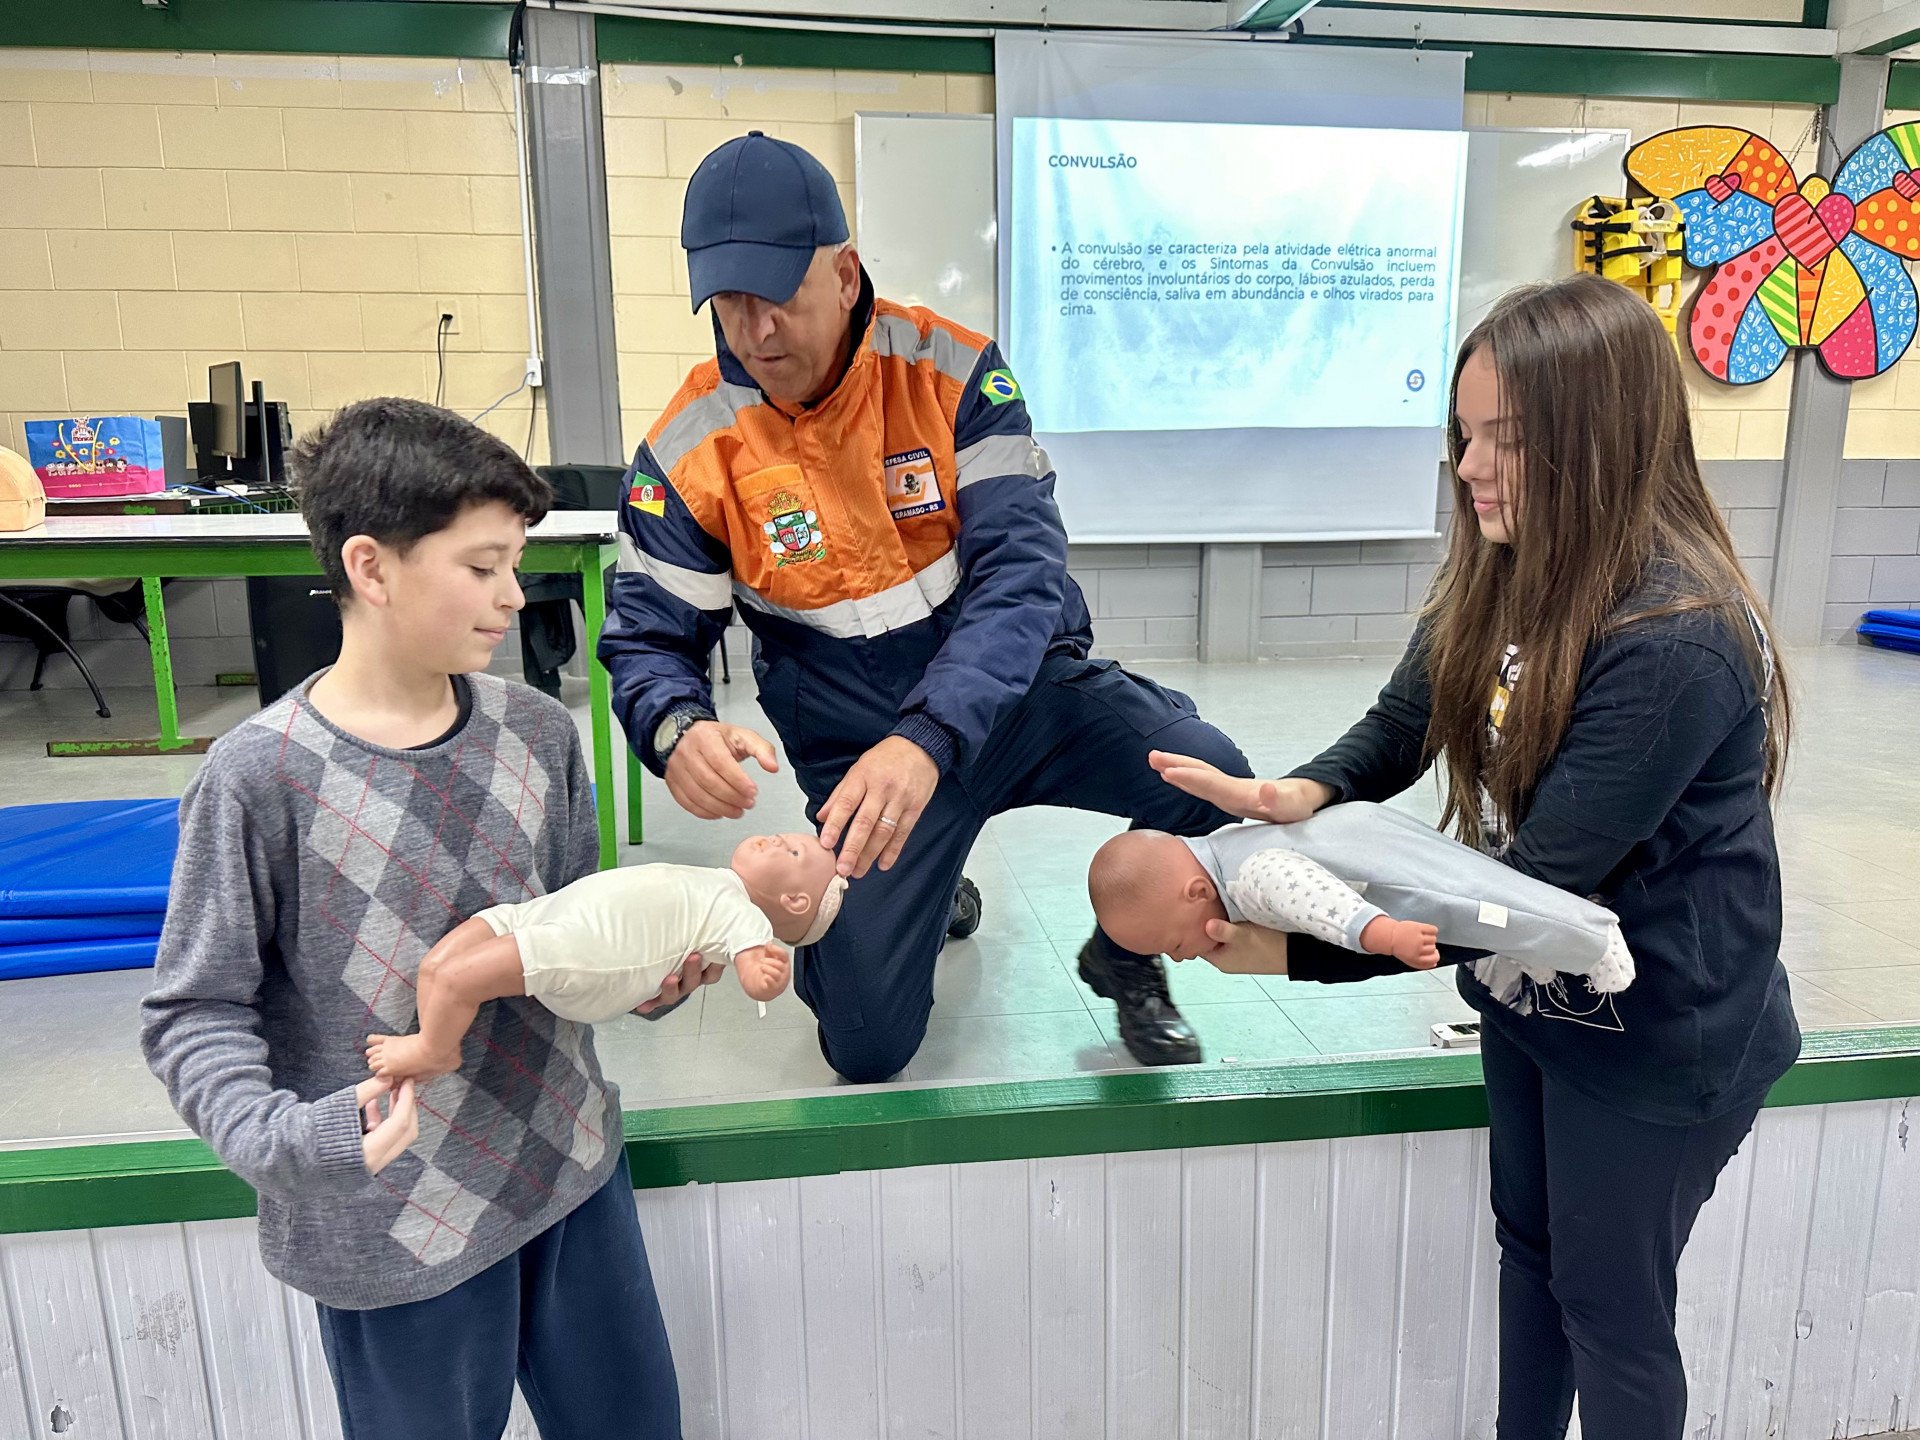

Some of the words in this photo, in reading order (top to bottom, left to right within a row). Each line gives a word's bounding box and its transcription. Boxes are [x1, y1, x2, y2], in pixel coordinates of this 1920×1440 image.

[1048, 153, 1137, 169] CONVULSÃO
[1061, 242, 1072, 254] A
[1078, 242, 1142, 254] convulsão
[1148, 244, 1162, 254] se
[1168, 242, 1237, 254] caracteriza
[1243, 242, 1269, 256] pela
[1275, 243, 1331, 255] atividade
[1338, 244, 1381, 256] elétrica
[1386, 246, 1437, 257] anormal
[1061, 257, 1079, 269] do
[1093, 257, 1144, 272] cérebro,
[1159, 259, 1167, 269] e
[1182, 259, 1196, 269] os
[1210, 256, 1268, 270] Sintomas
[1282, 258, 1297, 270] da
[1311, 259, 1374, 271] Convulsão
[1387, 260, 1436, 271] incluem
[1061, 272, 1142, 285] movimentos
[1148, 272, 1230, 285] involuntários
[1235, 272, 1251, 284] do
[1256, 275, 1294, 287] corpo,
[1299, 274, 1336, 285] lábios
[1340, 275, 1395, 287] azulados,
[1401, 275, 1435, 289] perda
[1061, 288, 1078, 300] de
[1084, 287, 1160, 302] consciência,
[1166, 288, 1200, 300] saliva
[1206, 289, 1226, 299] em
[1232, 288, 1304, 300] abundância
[1311, 290, 1318, 299] e
[1323, 288, 1355, 300] olhos
[1360, 289, 1403, 300] virados
[1408, 291, 1434, 302] para
[1060, 303, 1096, 316] cima.
[885, 456, 907, 466] EFESA
[907, 450, 928, 460] CIVIL
[894, 507, 925, 519] GRAMADO
[929, 503, 939, 511] RS
